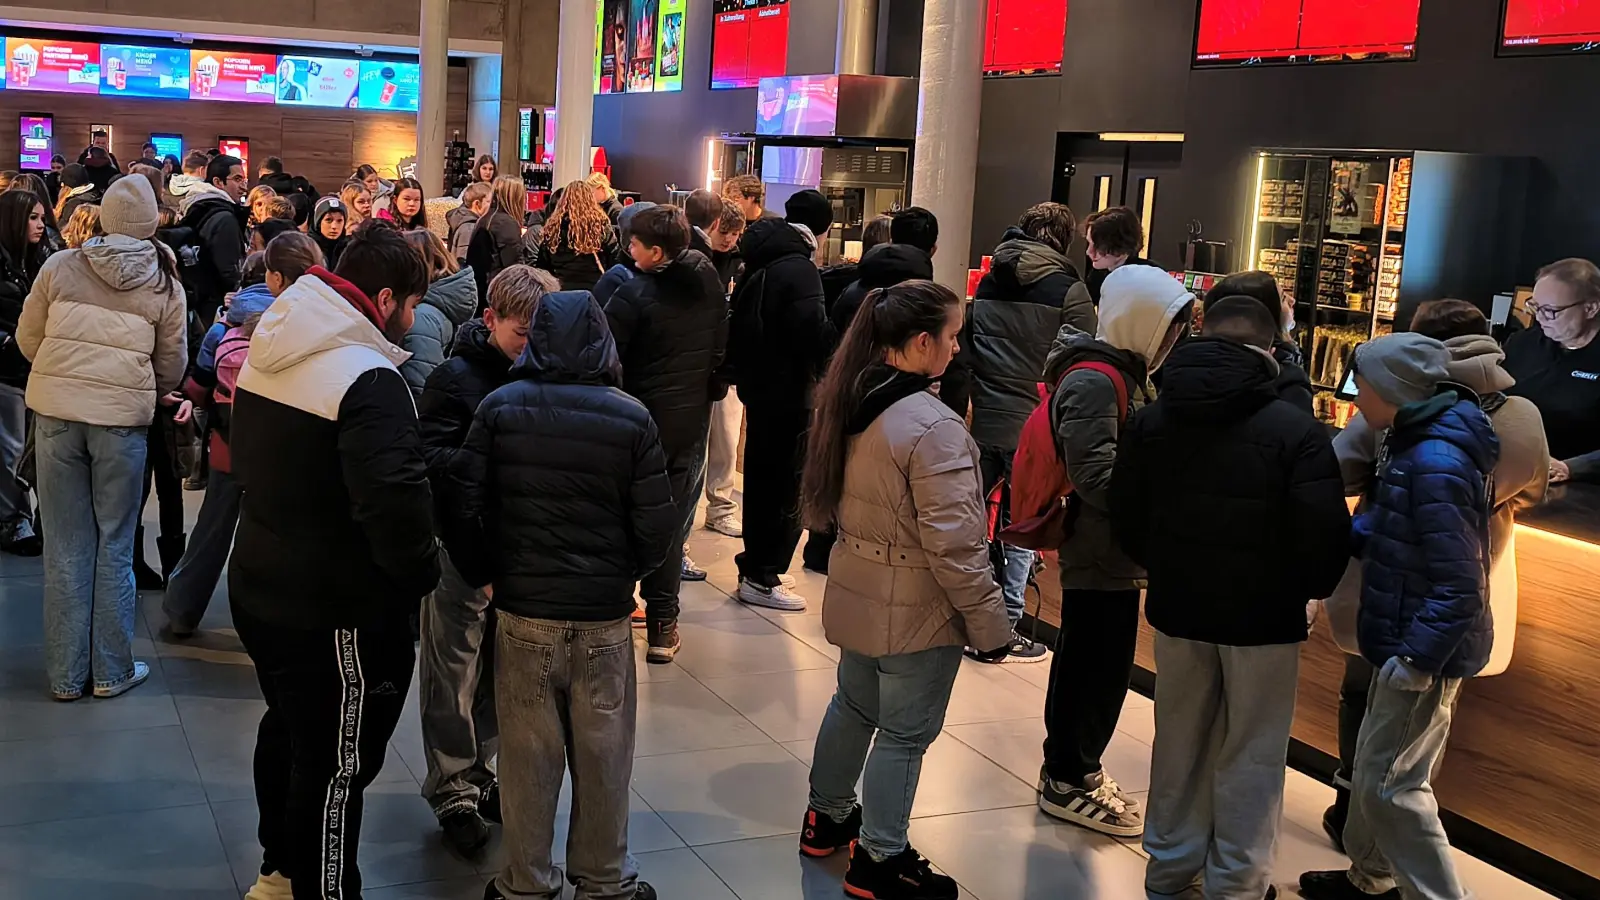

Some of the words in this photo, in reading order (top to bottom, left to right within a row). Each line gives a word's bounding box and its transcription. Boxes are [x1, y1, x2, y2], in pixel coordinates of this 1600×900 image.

[343, 644, 357, 683] Kappa
[346, 700, 357, 737] Kappa
[327, 848, 339, 891] Kappa
